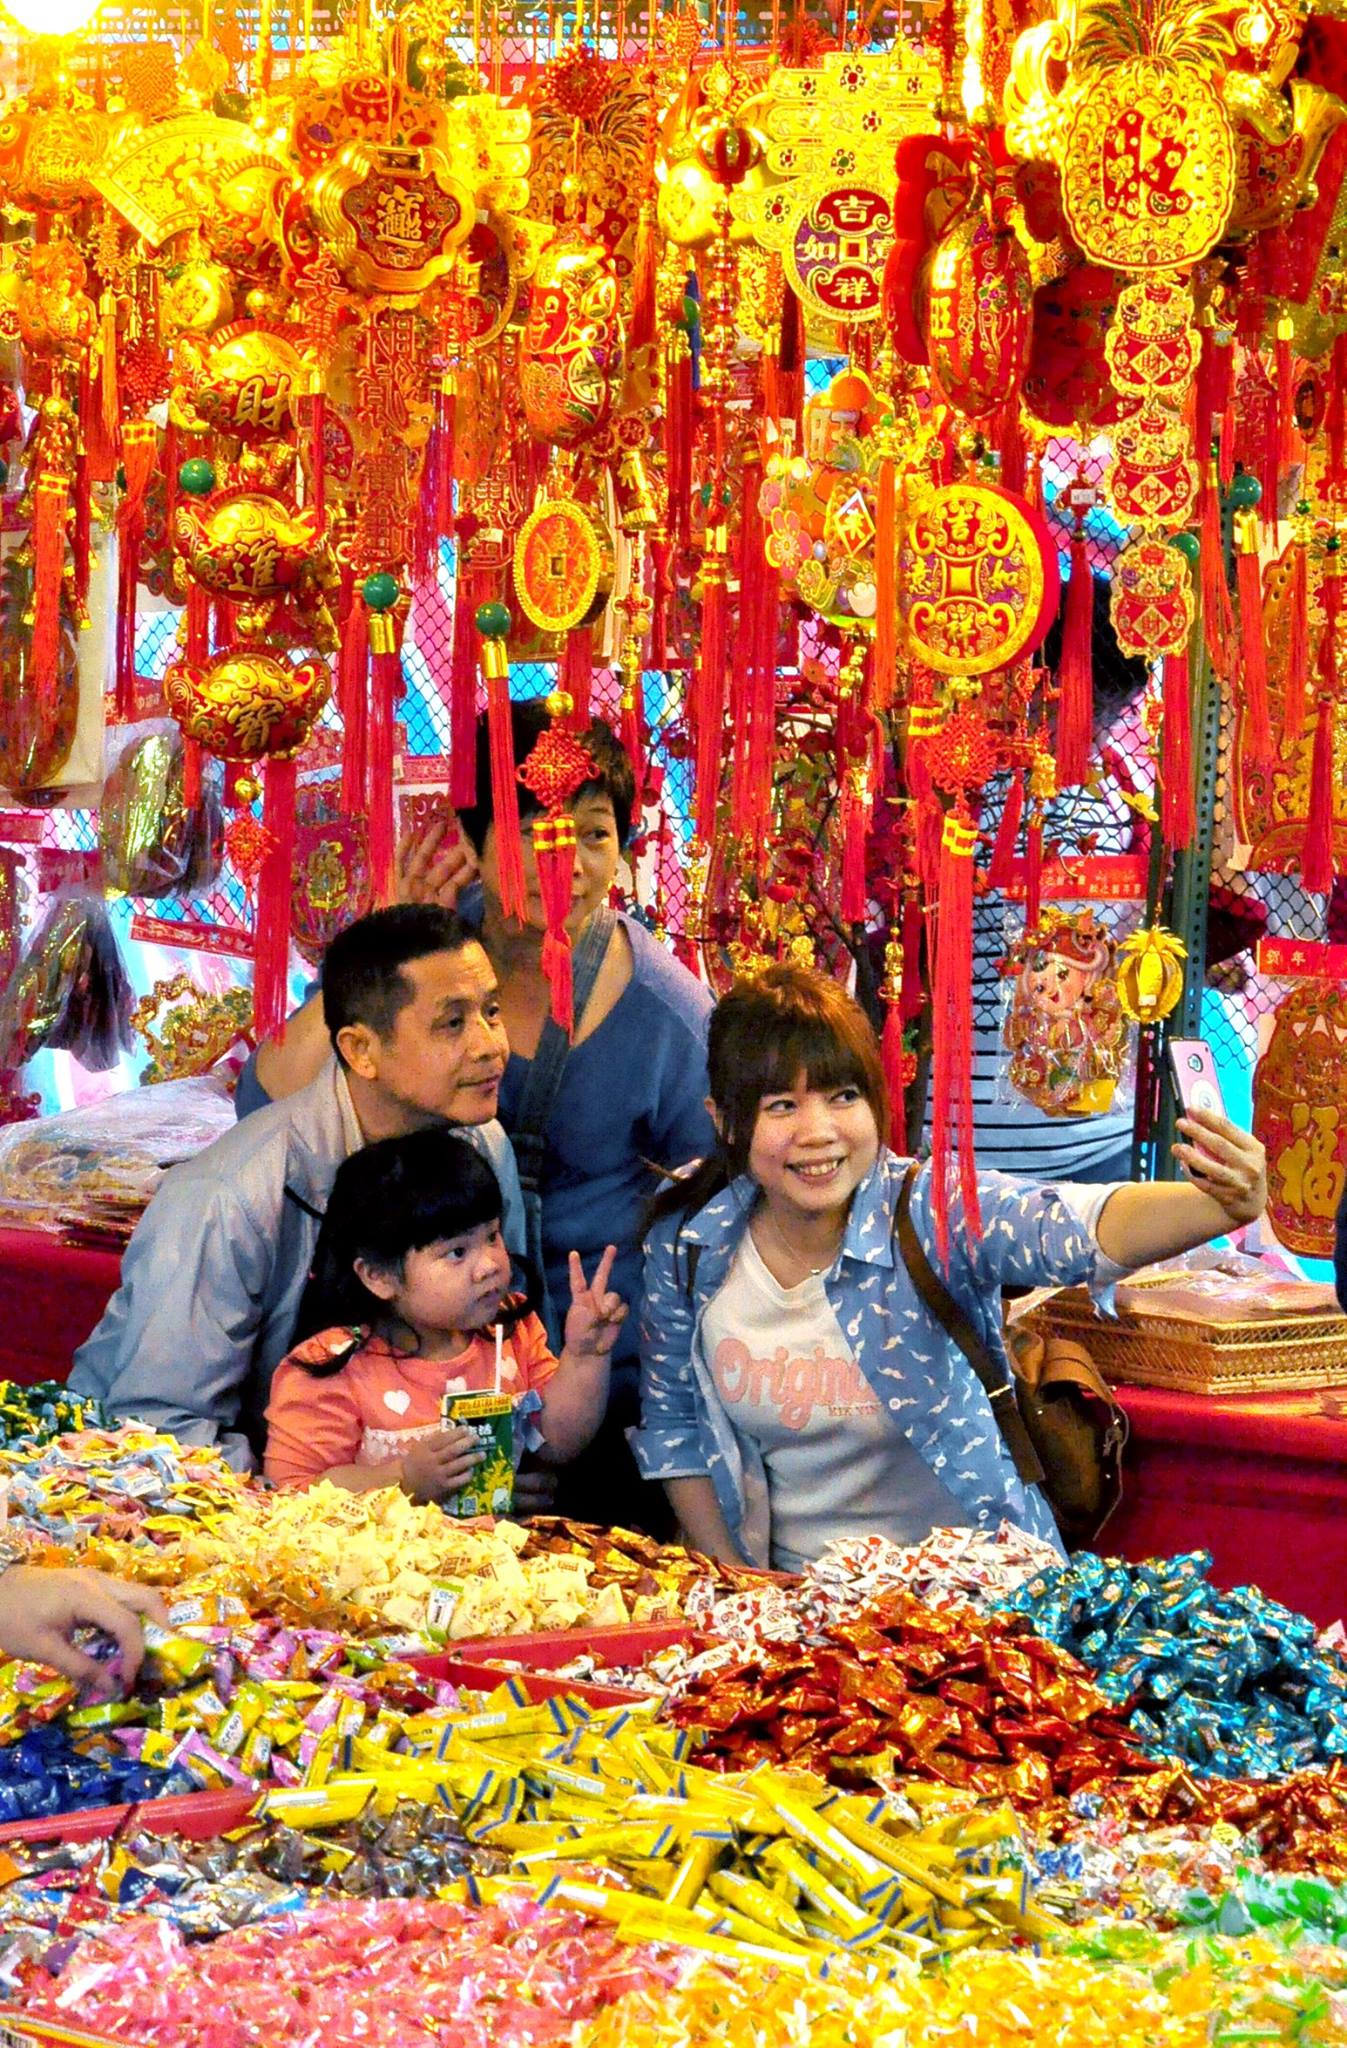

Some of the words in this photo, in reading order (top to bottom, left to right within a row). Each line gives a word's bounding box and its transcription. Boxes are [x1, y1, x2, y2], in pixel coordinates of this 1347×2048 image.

[1103, 106, 1193, 220] 旺
[833, 195, 875, 223] 吉
[796, 234, 836, 261] 如
[830, 276, 872, 304] 祥
[232, 376, 290, 431] 財
[946, 506, 974, 541] 吉
[228, 539, 290, 596] 進
[1277, 1101, 1346, 1220] 福
